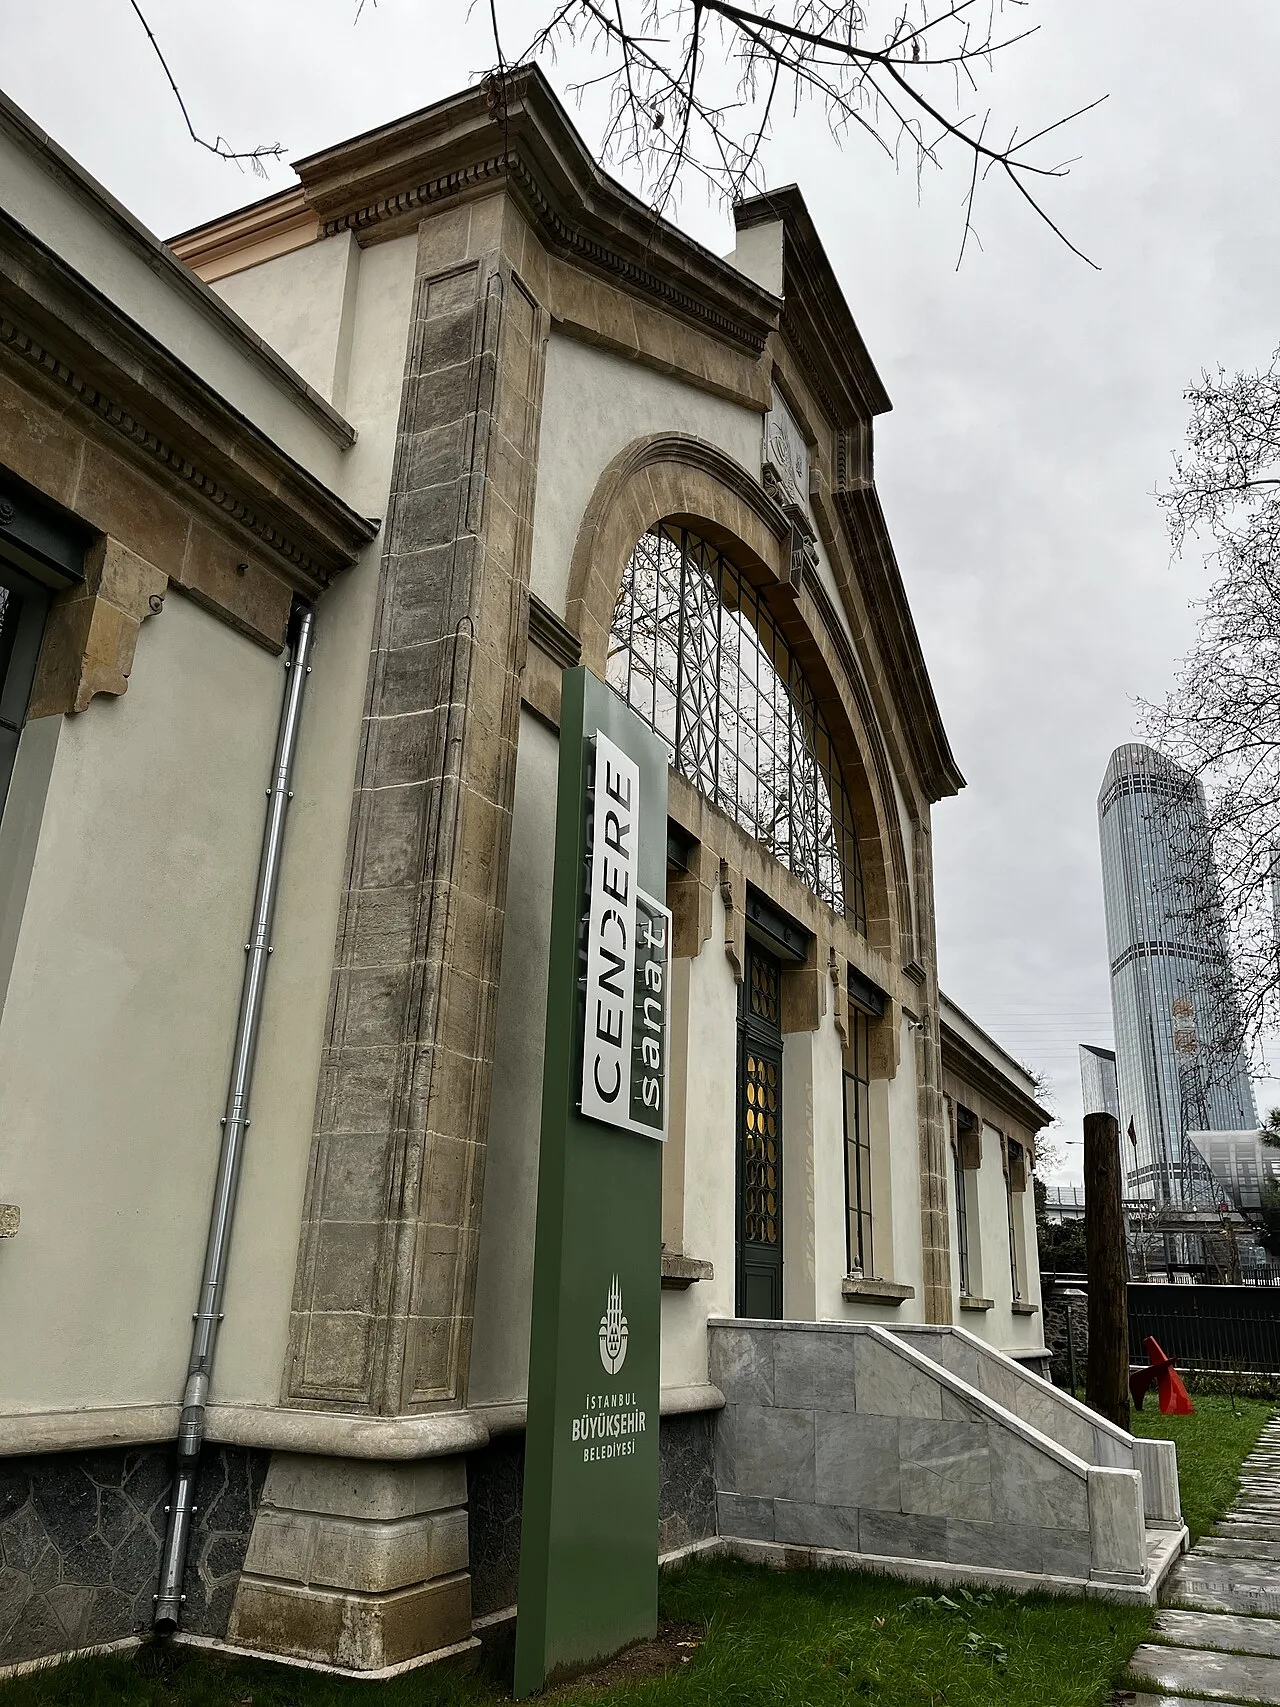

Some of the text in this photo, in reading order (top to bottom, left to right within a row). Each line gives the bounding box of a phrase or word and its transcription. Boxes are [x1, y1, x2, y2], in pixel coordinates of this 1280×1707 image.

[593, 760, 631, 1104] CENDERE
[641, 919, 666, 1112] sanat
[586, 1392, 636, 1409] İSTANBUL
[572, 1408, 646, 1441] BÜYÜKŞEHİR
[583, 1438, 635, 1462] BELEDİYESİ
